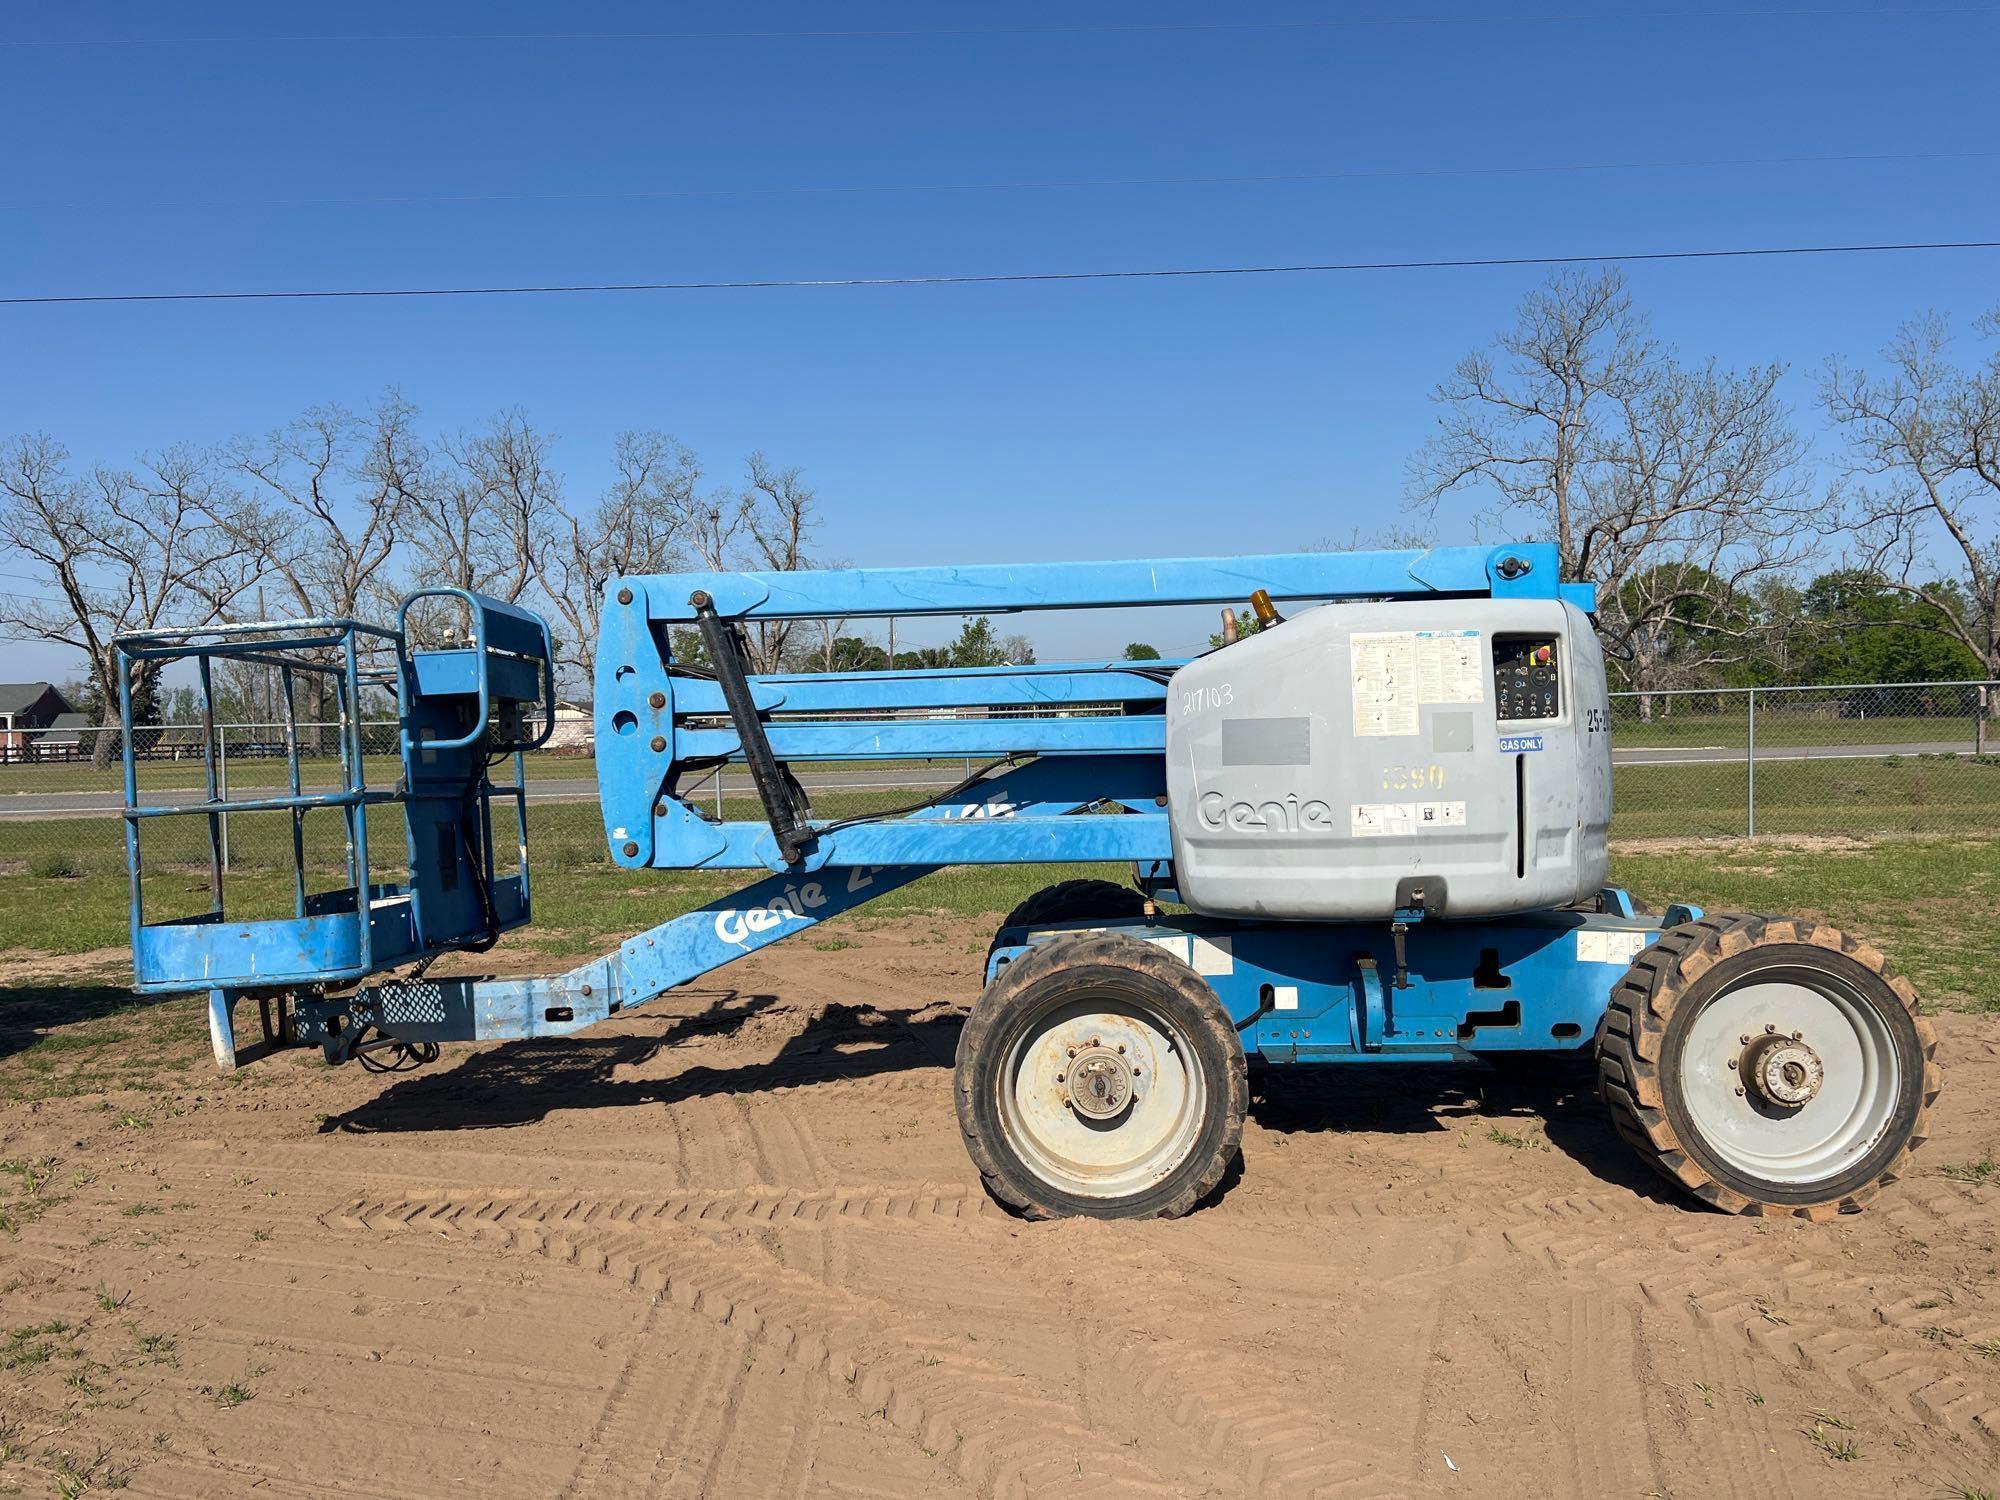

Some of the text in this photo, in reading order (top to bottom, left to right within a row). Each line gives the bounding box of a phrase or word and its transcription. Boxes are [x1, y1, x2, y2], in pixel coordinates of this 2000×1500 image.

[1183, 683, 1234, 716] 217103
[1500, 739, 1542, 750] GAS ONLY
[714, 882, 828, 944] Genie
